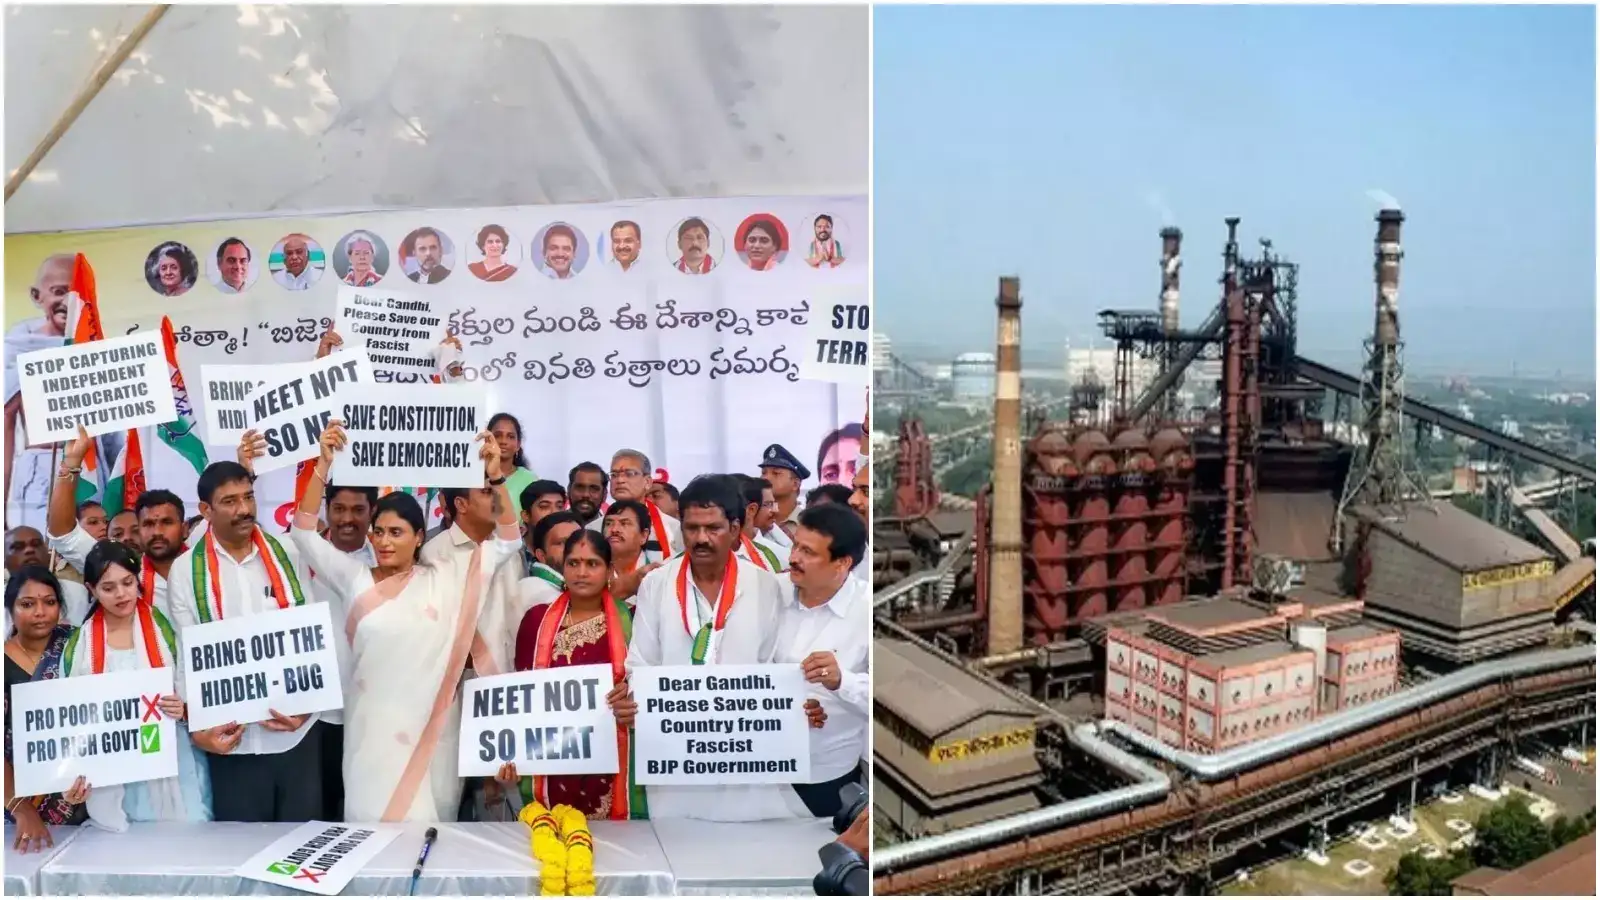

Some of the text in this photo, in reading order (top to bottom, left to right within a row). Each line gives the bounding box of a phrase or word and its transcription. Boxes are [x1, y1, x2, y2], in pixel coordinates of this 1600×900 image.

[343, 307, 441, 327] Please Save our
[353, 294, 432, 312] Dear Gandhi,
[351, 322, 430, 339] Country from
[523, 306, 601, 338] నుండి
[609, 302, 648, 331] ఈ
[655, 299, 753, 336] దేశాన్ని
[24, 342, 158, 376] STOP CAPTURING
[366, 338, 410, 351] Fascist
[367, 352, 435, 367] overnment
[816, 339, 869, 366] TERR
[42, 363, 146, 393] INDEPENDENT
[523, 352, 596, 384] వినతి
[604, 350, 701, 388] పత్రాలు
[46, 382, 148, 412] DEMOCRATIC
[253, 360, 359, 422] NEET NOT
[46, 400, 156, 431] INSTITUTIONS
[342, 404, 479, 433] SAVE CONSTITUTION,
[264, 422, 300, 457] SO
[352, 441, 471, 468] SAVE DEMOCRACY.
[191, 624, 326, 672] BRING OUT THE
[200, 671, 269, 708] HIDDEN
[283, 663, 324, 694] BUG
[473, 678, 599, 718] NEET NOT
[658, 674, 775, 692] Dear Gandhi,
[25, 697, 140, 732] PRO POOR GOVT
[647, 696, 794, 713] Please Save our
[660, 717, 782, 733] Country from
[26, 728, 139, 763] PRO RICH GOVT
[479, 725, 594, 762] SO NEAT
[686, 738, 754, 753] Fascist
[647, 758, 798, 774] BJP Government
